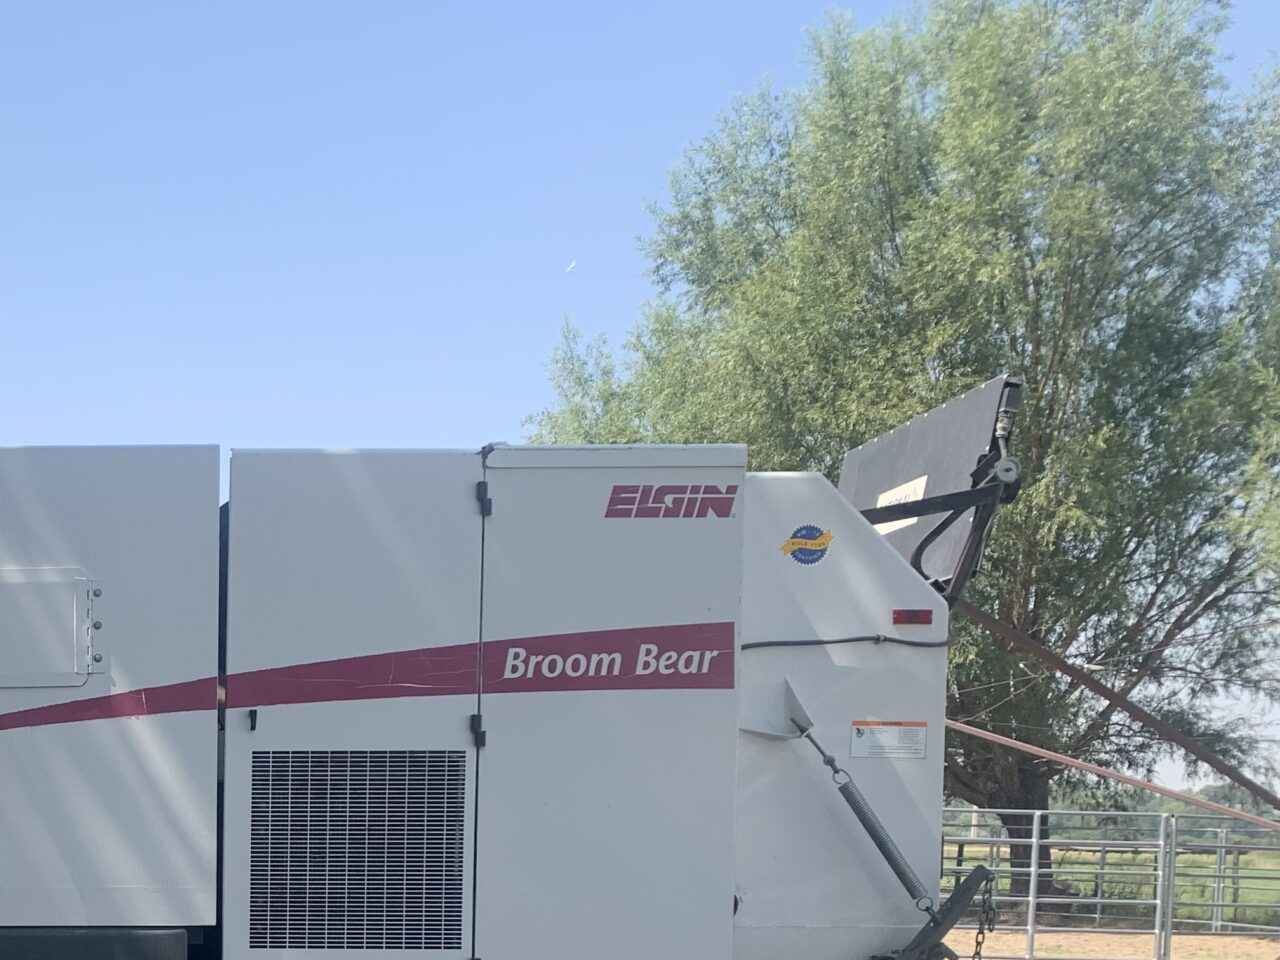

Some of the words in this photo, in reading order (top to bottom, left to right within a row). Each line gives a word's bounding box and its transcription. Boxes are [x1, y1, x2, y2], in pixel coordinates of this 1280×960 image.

[604, 484, 739, 518] ELGIN
[503, 647, 622, 680] Broom
[635, 643, 719, 676] Bear
